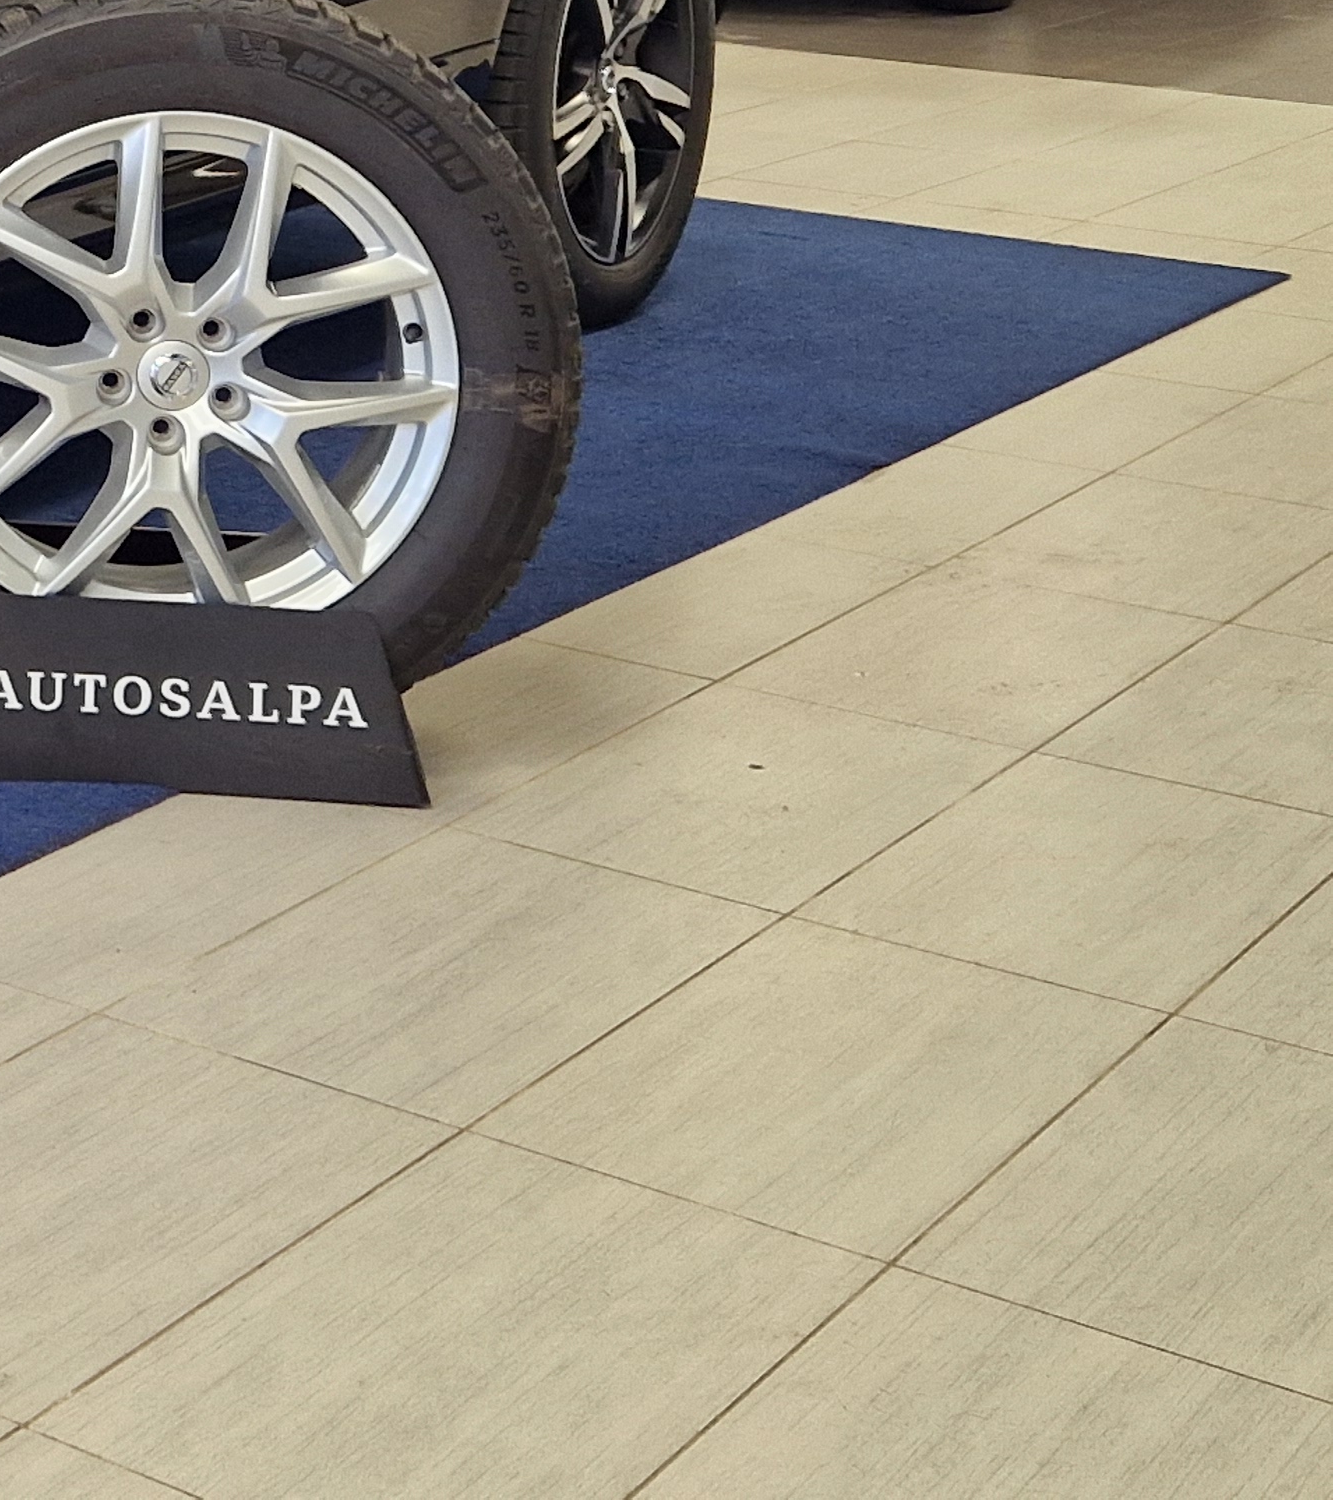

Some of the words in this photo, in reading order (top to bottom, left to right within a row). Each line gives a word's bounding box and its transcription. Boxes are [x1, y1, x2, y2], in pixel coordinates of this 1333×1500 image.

[293, 49, 479, 190] MICHELIN
[480, 211, 531, 295] 235/60
[518, 302, 537, 319] R
